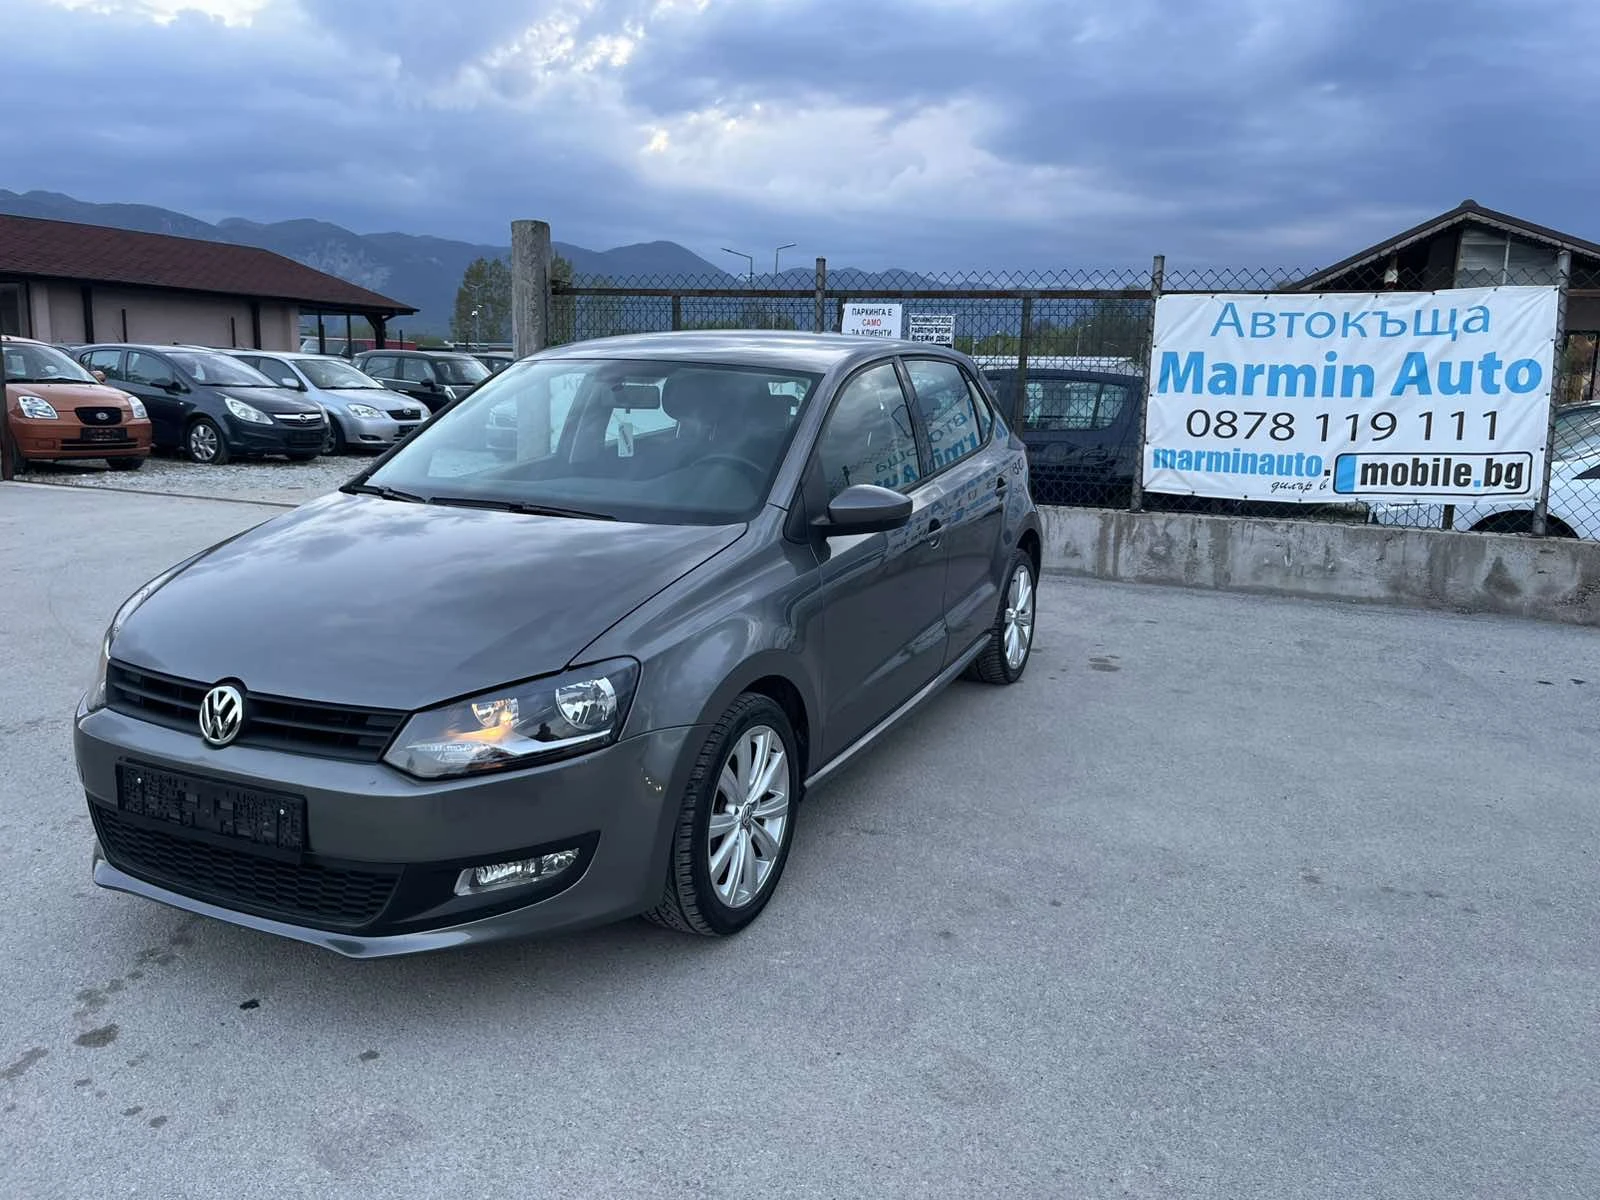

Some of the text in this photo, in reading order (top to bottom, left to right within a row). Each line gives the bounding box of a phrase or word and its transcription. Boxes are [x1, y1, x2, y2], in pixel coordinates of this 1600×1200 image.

[851, 308, 892, 317] ПАРКИНГА Е
[862, 318, 882, 327] САМО
[1210, 302, 1491, 342] Автокъща
[1157, 350, 1543, 398] Marmin Auto
[1186, 409, 1498, 443] 0878 119 111
[1360, 457, 1524, 490] mobile.bg
